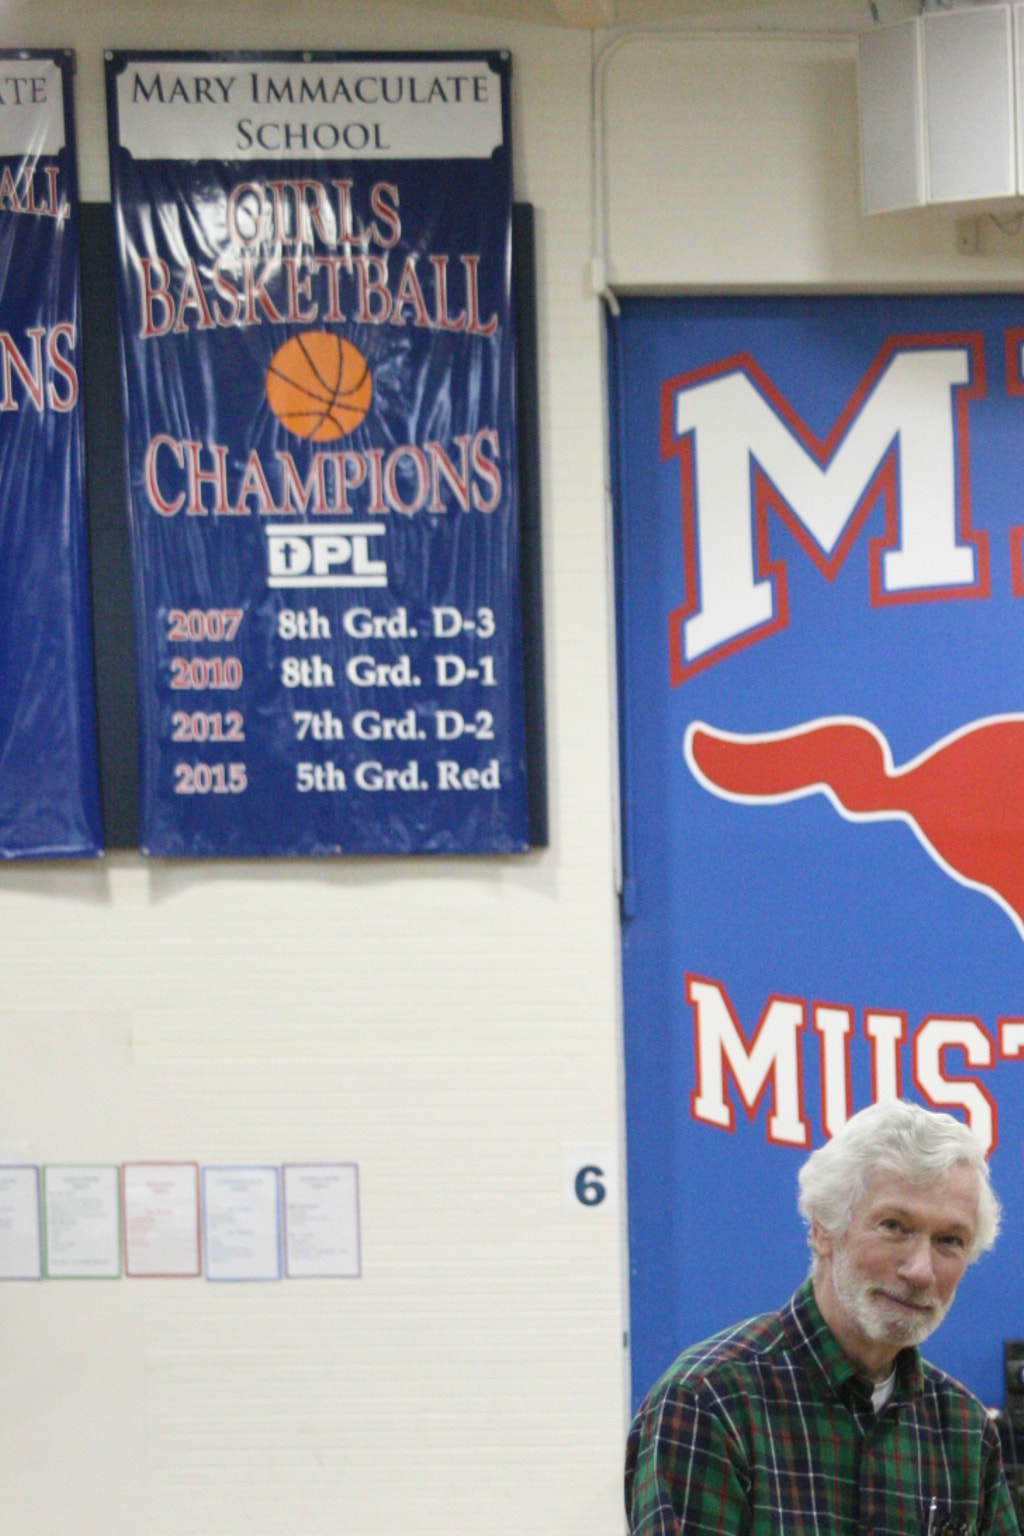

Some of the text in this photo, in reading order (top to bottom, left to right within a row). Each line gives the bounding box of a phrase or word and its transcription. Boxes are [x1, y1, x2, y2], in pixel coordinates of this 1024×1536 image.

[0, 77, 47, 105] TE
[132, 72, 490, 104] MARY IMMACULATE
[236, 119, 391, 152] SCHOOL
[226, 179, 402, 248] GIRLS
[139, 255, 499, 339] BASKETBALL
[144, 431, 502, 516] CHAMPIONS
[268, 535, 387, 576] DPL
[168, 607, 496, 642] 2007 8th Grd. D-3
[170, 655, 498, 689] 2010 8th Grd. D-1
[172, 710, 495, 742] 2012 7th Grd. D-2
[174, 759, 501, 794] 2015 5th Grd. Red
[575, 1165, 606, 1206] 6
